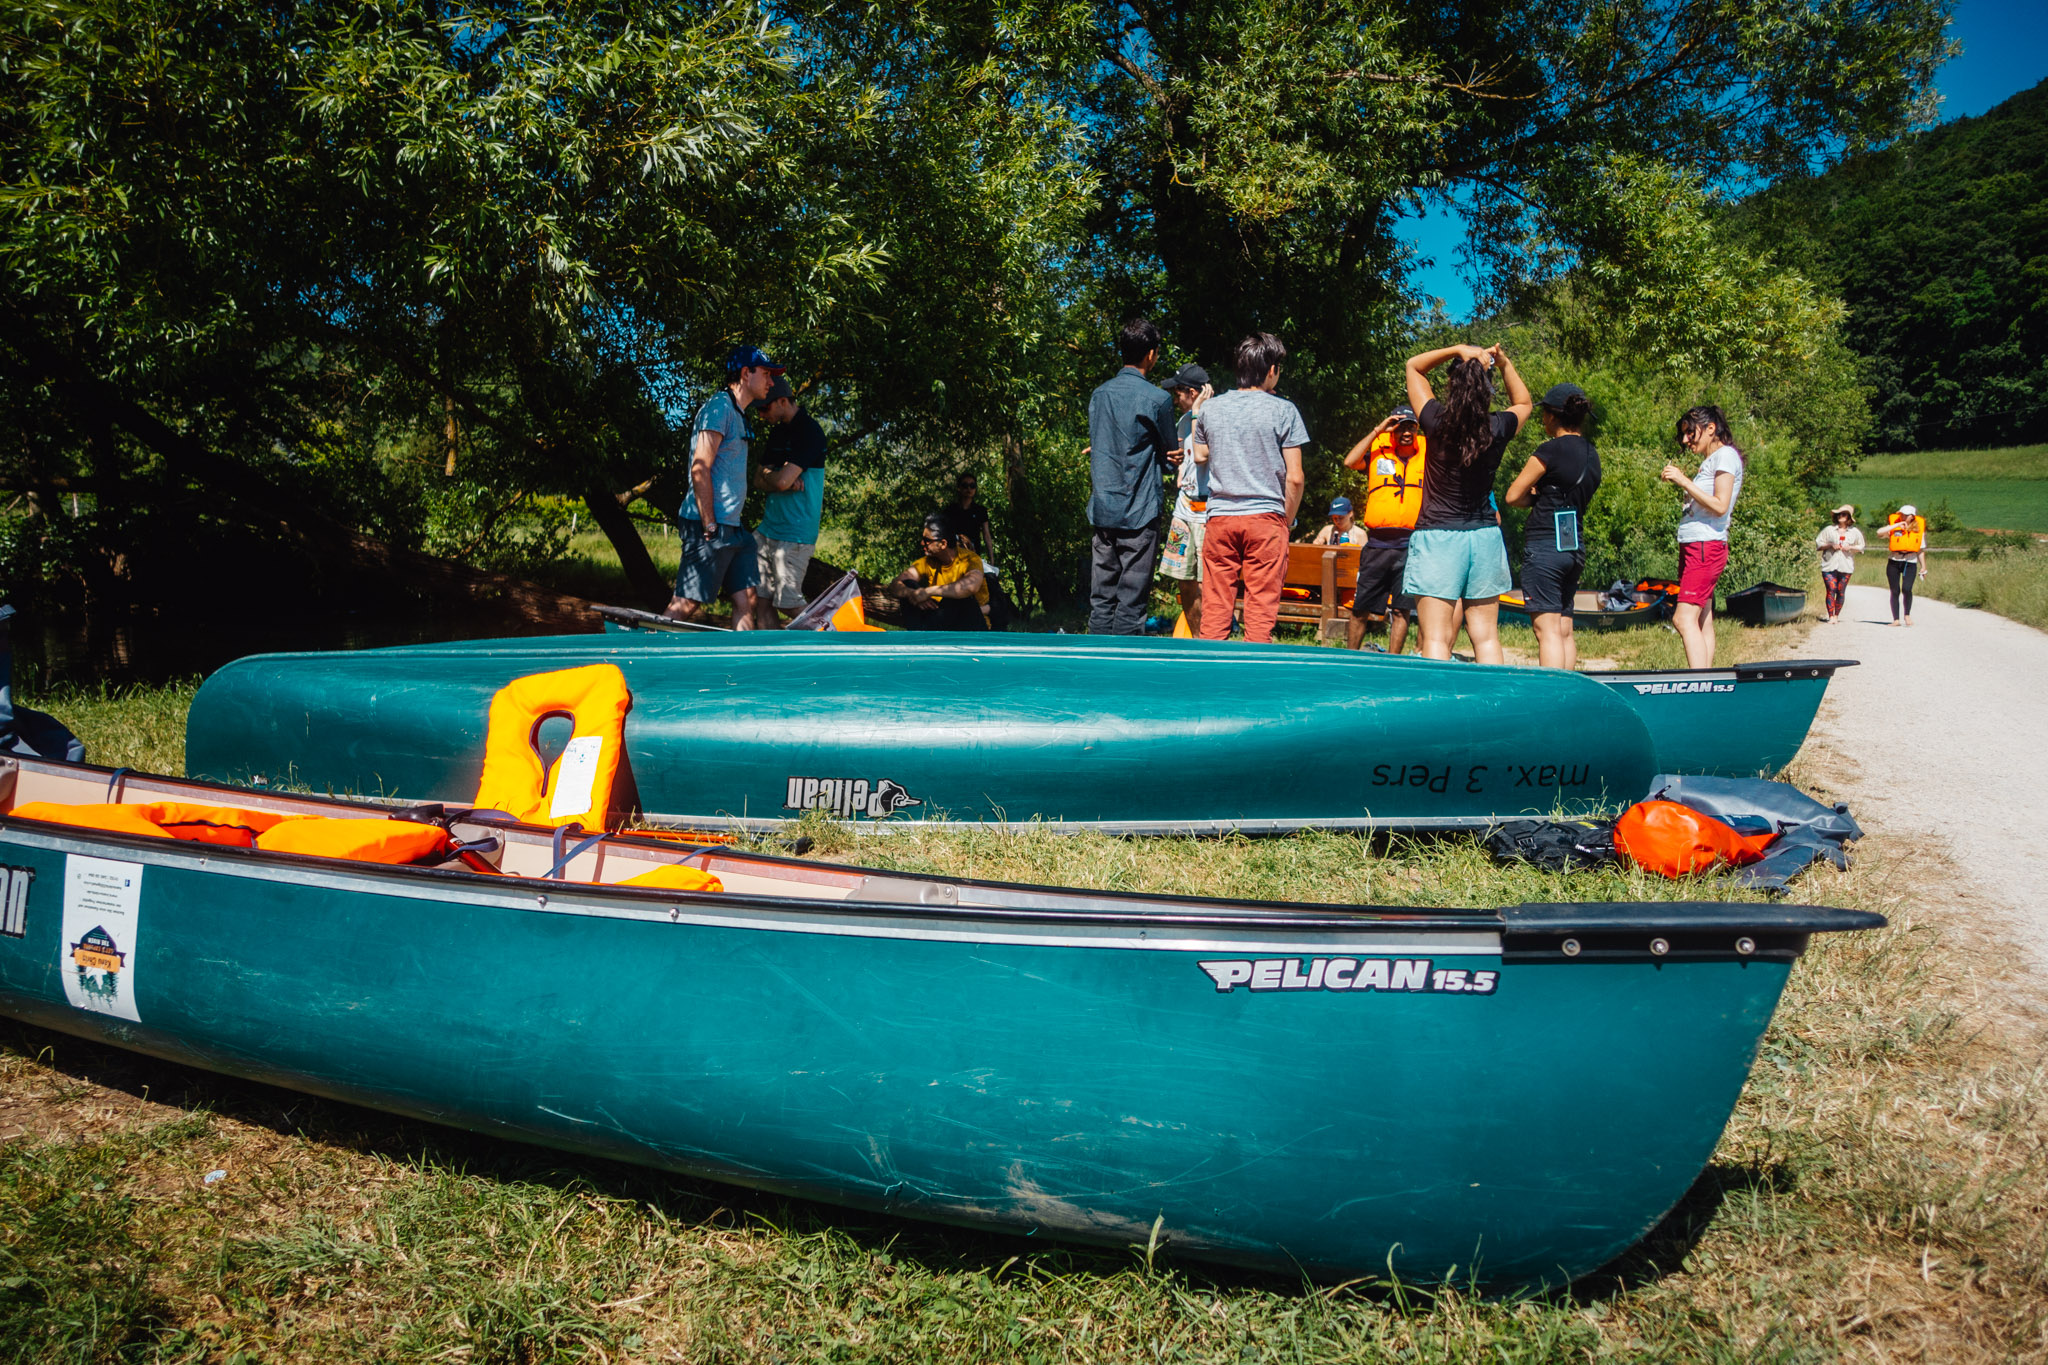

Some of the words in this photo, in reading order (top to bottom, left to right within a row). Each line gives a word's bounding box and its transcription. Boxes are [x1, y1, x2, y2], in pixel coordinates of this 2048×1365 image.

[1633, 681, 1713, 695] PELICAN
[1713, 684, 1735, 692] 15.5
[1371, 764, 1451, 793] Pers
[1465, 765, 1488, 793] 3
[1507, 764, 1590, 787] max.
[787, 778, 887, 817] Pelican
[98, 958, 112, 969] Kanu
[1198, 958, 1430, 990] PELICAN
[1432, 970, 1496, 991] 15.5
